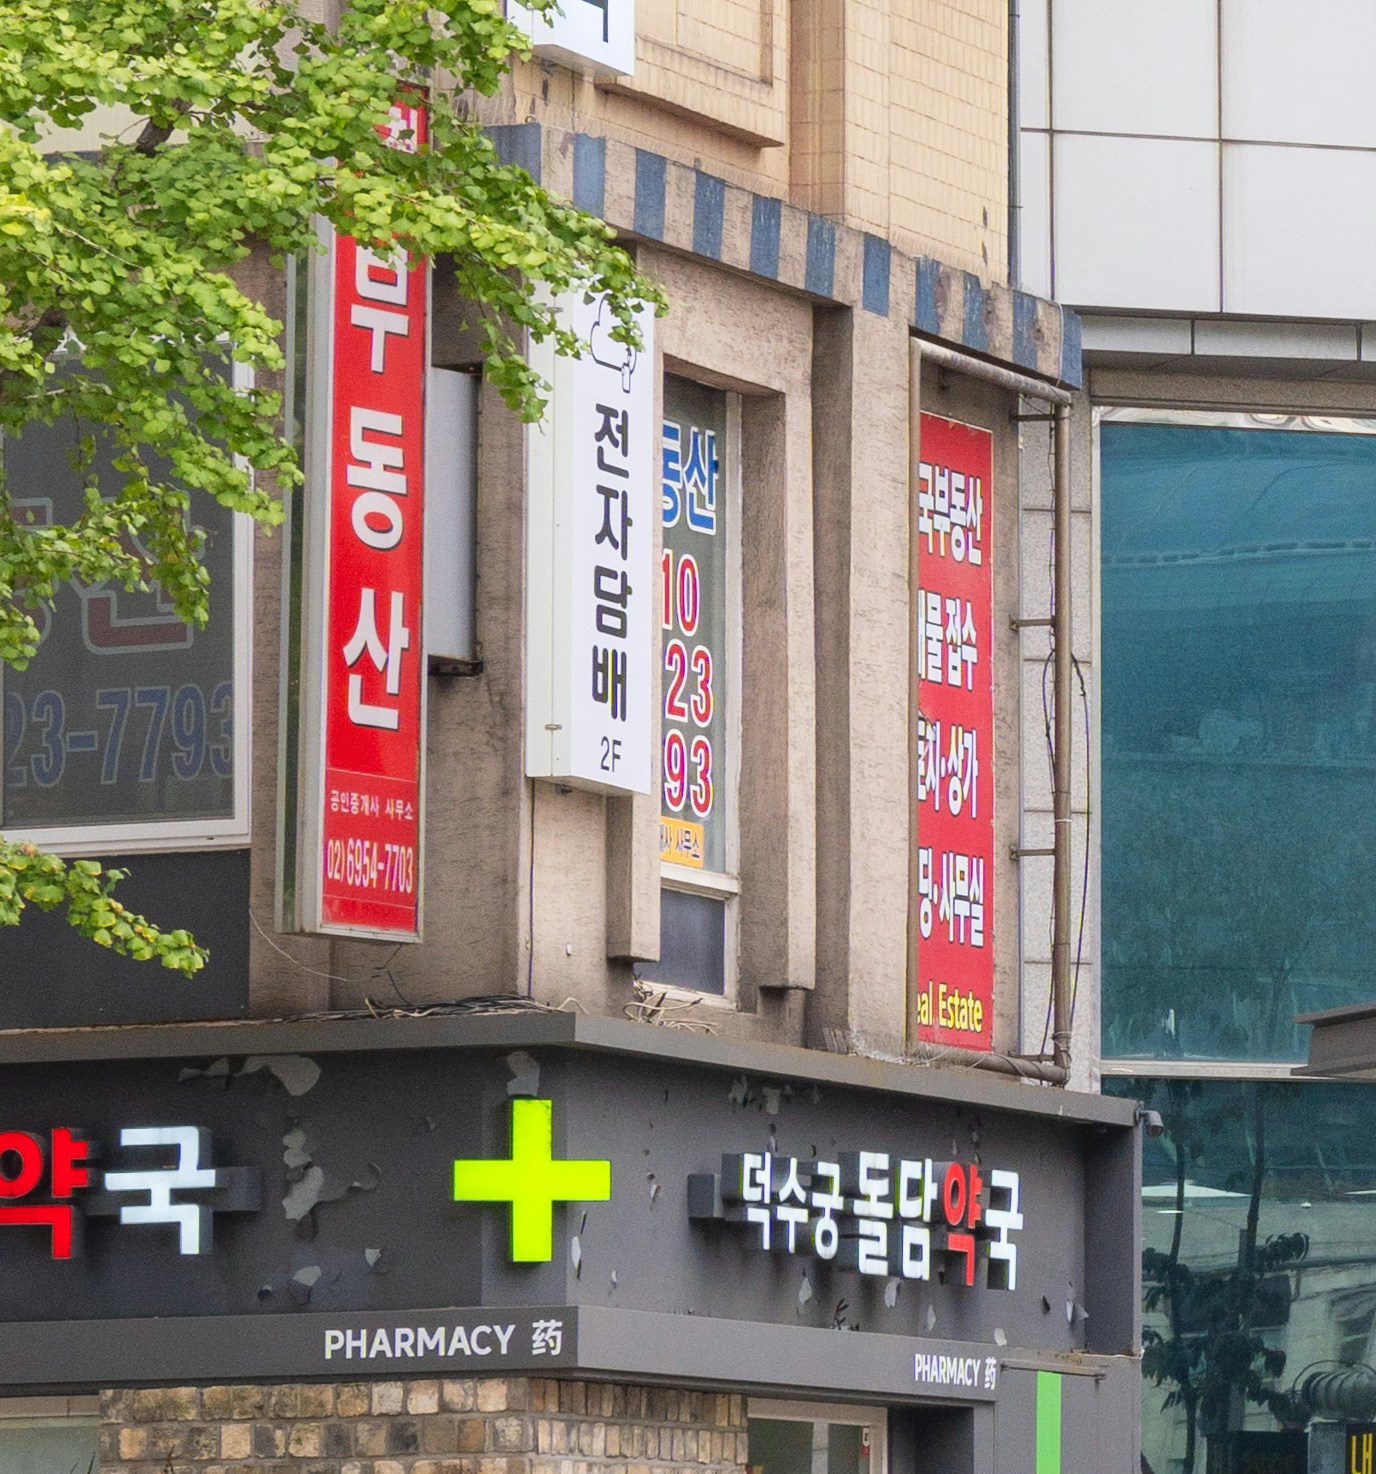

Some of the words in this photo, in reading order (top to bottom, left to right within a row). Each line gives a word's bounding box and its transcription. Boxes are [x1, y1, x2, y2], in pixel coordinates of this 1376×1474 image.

[591, 402, 633, 722] 전자담배
[945, 597, 978, 691] 접수
[664, 638, 715, 728] 23
[599, 735, 622, 773] 2F
[664, 728, 715, 818] 93
[330, 788, 380, 818] 공인중개사
[384, 797, 414, 821] 사무소
[326, 837, 414, 895] 02)6954-7703
[676, 828, 700, 859] 사무소
[938, 983, 983, 1034] Estate
[0, 1126, 217, 1260] 약국
[741, 1151, 845, 1260] 덕수궁
[323, 1324, 516, 1361] PHARMACY
[531, 1319, 563, 1356] 药
[913, 1352, 980, 1389] PHARMACY
[983, 1355, 998, 1391] 药
